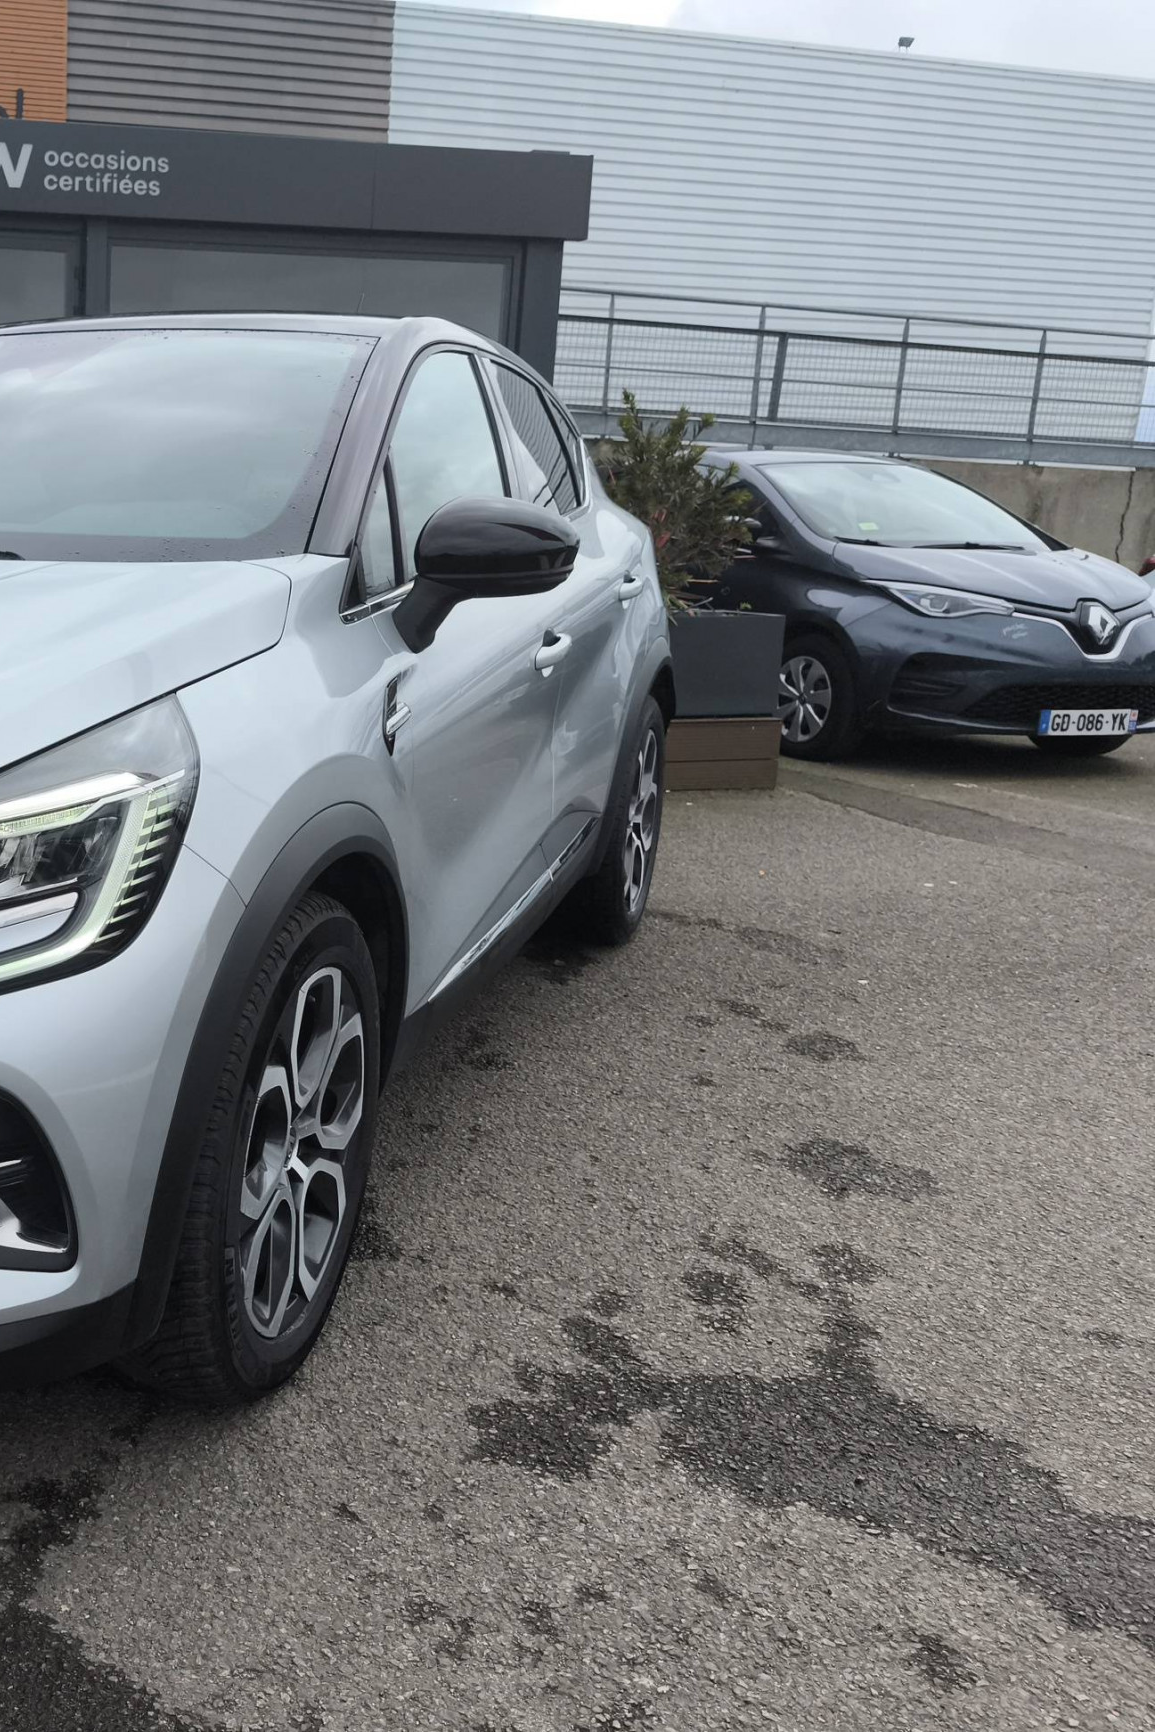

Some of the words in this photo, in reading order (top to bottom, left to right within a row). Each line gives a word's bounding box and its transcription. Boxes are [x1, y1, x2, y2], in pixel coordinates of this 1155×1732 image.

[44, 150, 170, 173] occasions
[43, 172, 161, 196] certifiées
[1051, 713, 1128, 732] GD-086-YK
